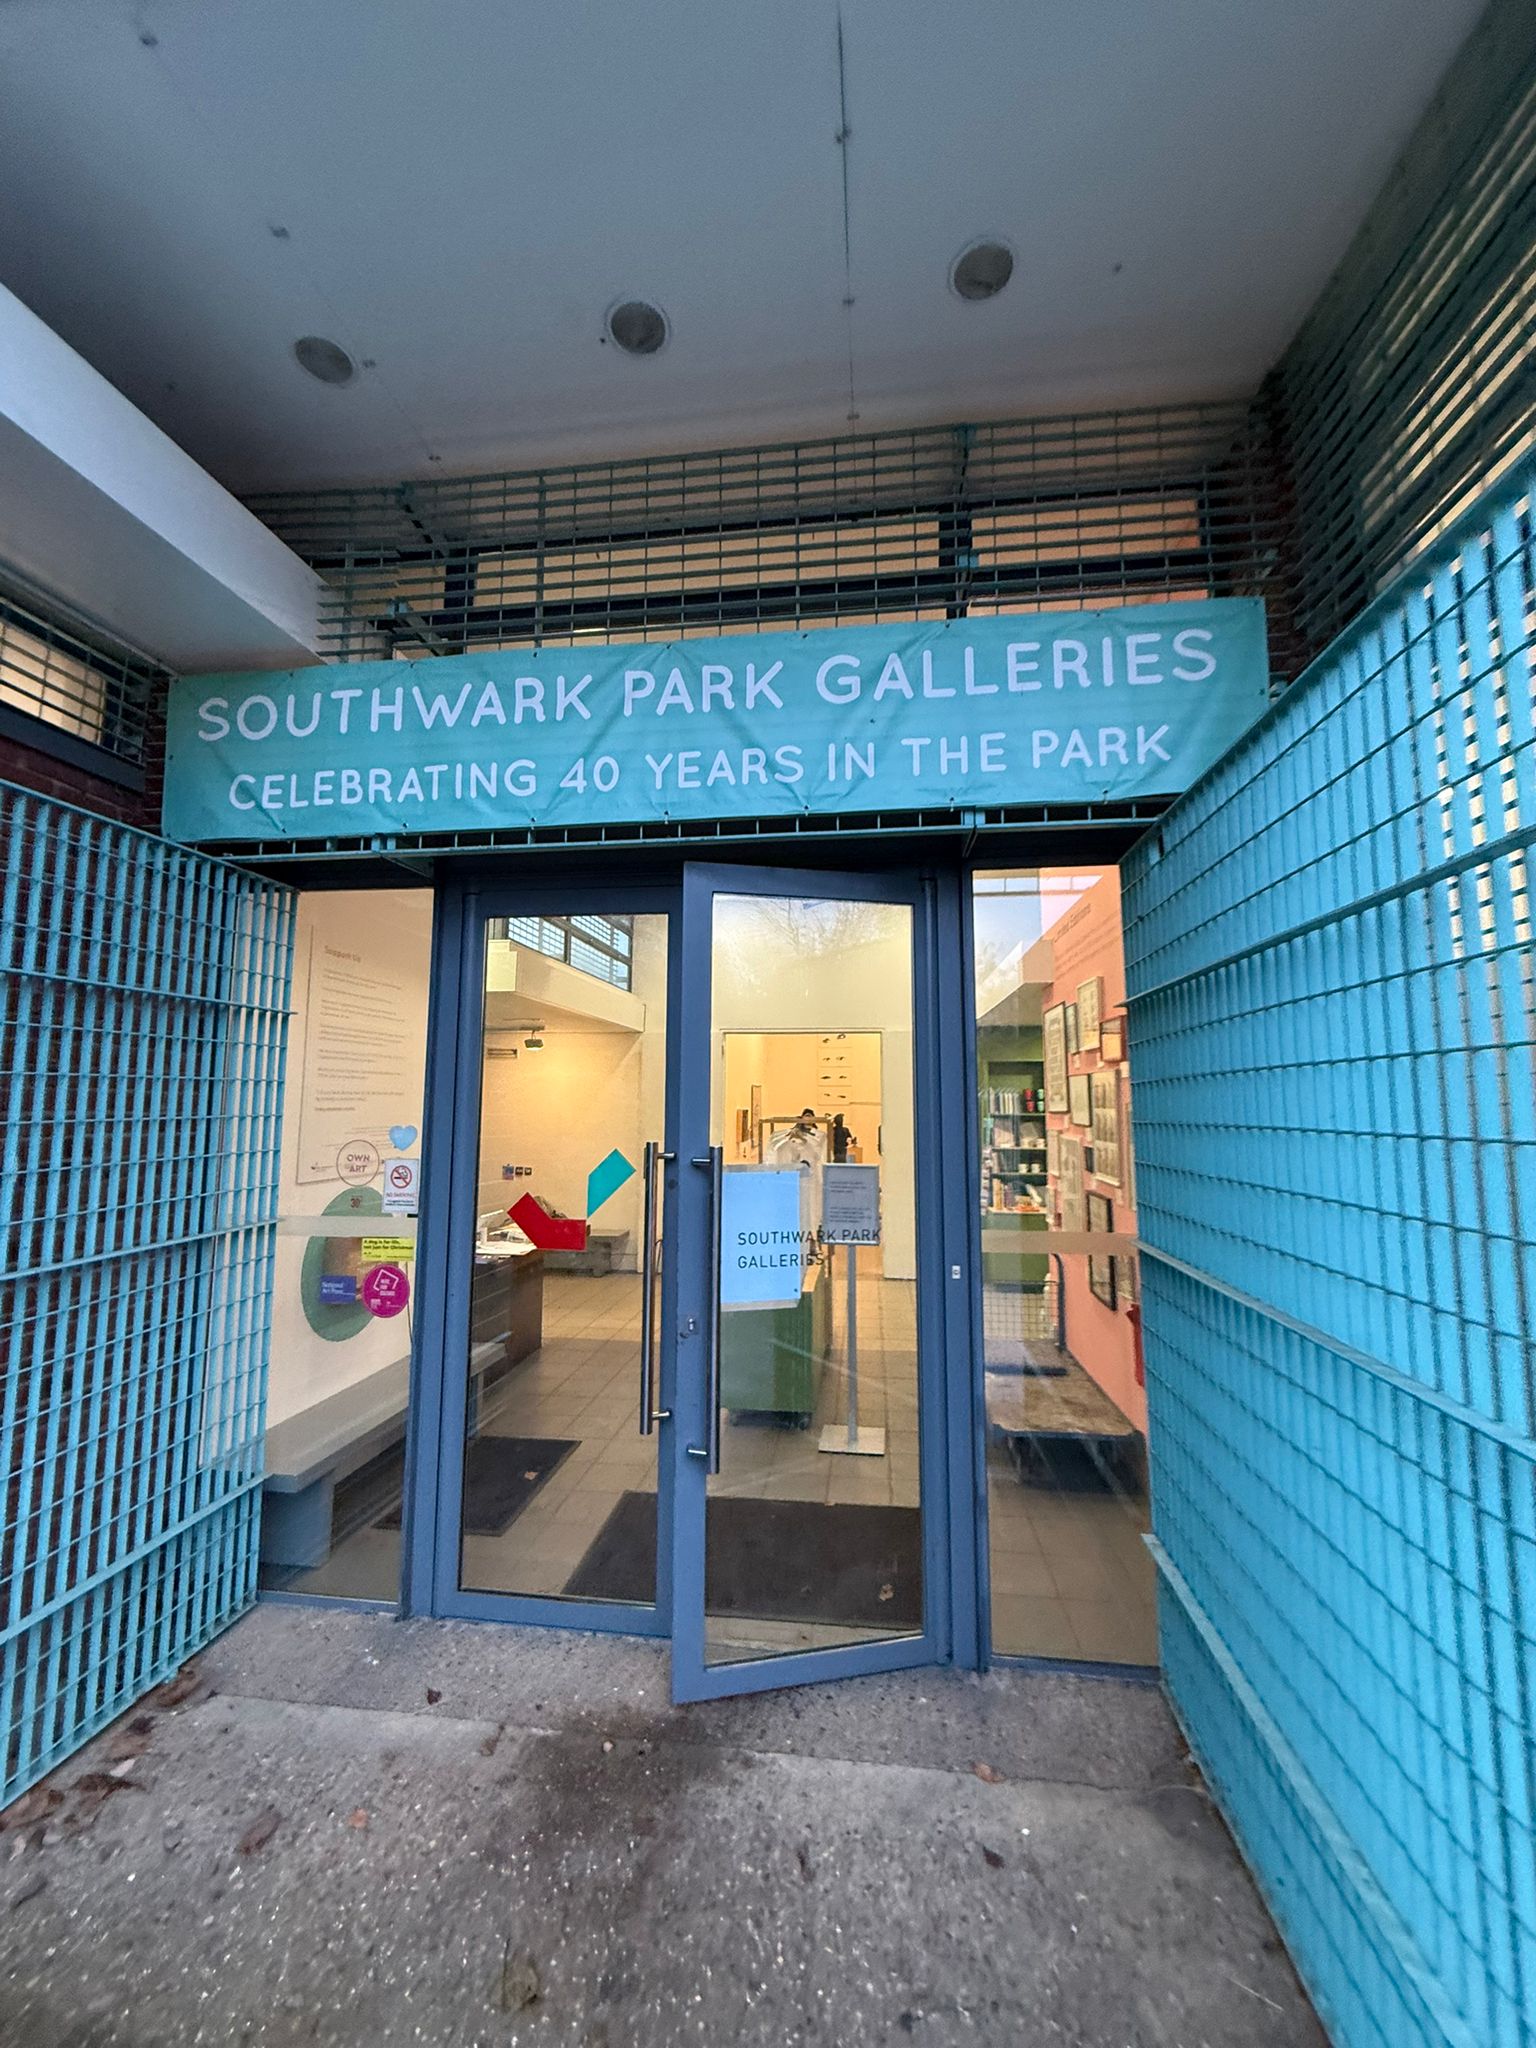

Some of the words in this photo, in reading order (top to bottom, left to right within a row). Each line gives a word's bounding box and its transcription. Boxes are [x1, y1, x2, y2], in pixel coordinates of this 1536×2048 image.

[198, 674, 593, 742] SOUTHWARK
[623, 661, 783, 718] PARK
[816, 628, 1218, 705] GALLERIES
[229, 758, 537, 811] CELEBRATING
[559, 756, 620, 793] 40
[645, 744, 804, 790] YEARS
[828, 742, 876, 781] IN
[901, 732, 1006, 776] THE
[1032, 724, 1171, 769] PARK
[346, 1153, 371, 1162] OWN
[349, 1164, 368, 1173] ART
[737, 1230, 836, 1246] SOUTHWARK
[842, 1228, 882, 1242] PARK
[737, 1252, 826, 1269] GALLERIES
